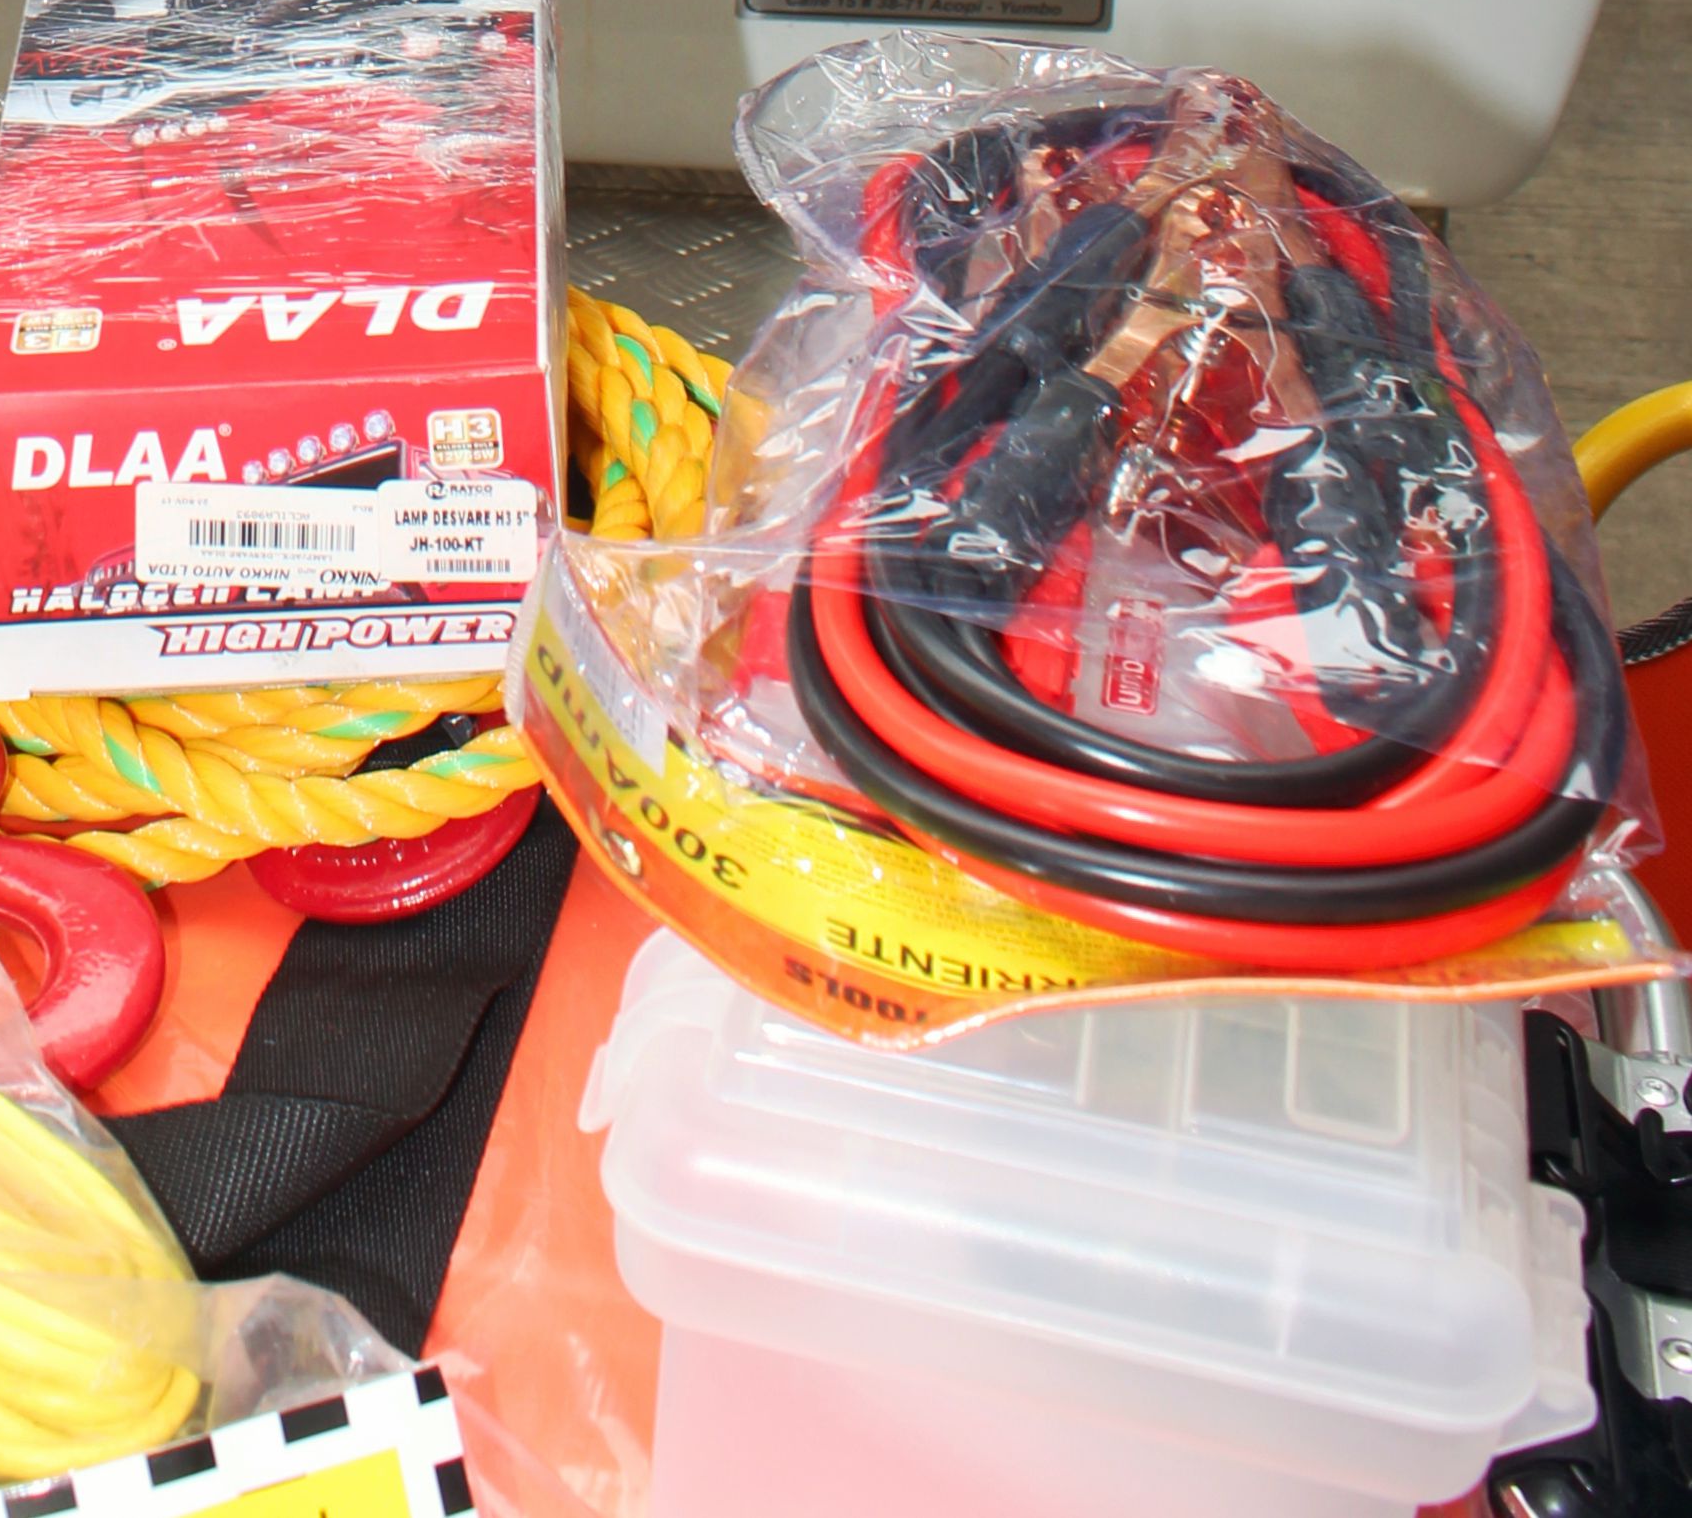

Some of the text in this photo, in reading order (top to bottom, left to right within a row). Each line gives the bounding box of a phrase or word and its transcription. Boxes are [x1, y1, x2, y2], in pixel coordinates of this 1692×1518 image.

[449, 483, 493, 494] RAYCO
[394, 509, 428, 526] LAMP
[433, 509, 491, 526] DESVARE
[496, 509, 512, 526] H3
[410, 536, 484, 552] JH-100-KT
[148, 563, 188, 576] LTDA
[193, 565, 235, 578] AUTO
[239, 566, 290, 580] NIKKO
[320, 568, 381, 585] NIKKO
[161, 611, 516, 655] HIGH POWER
